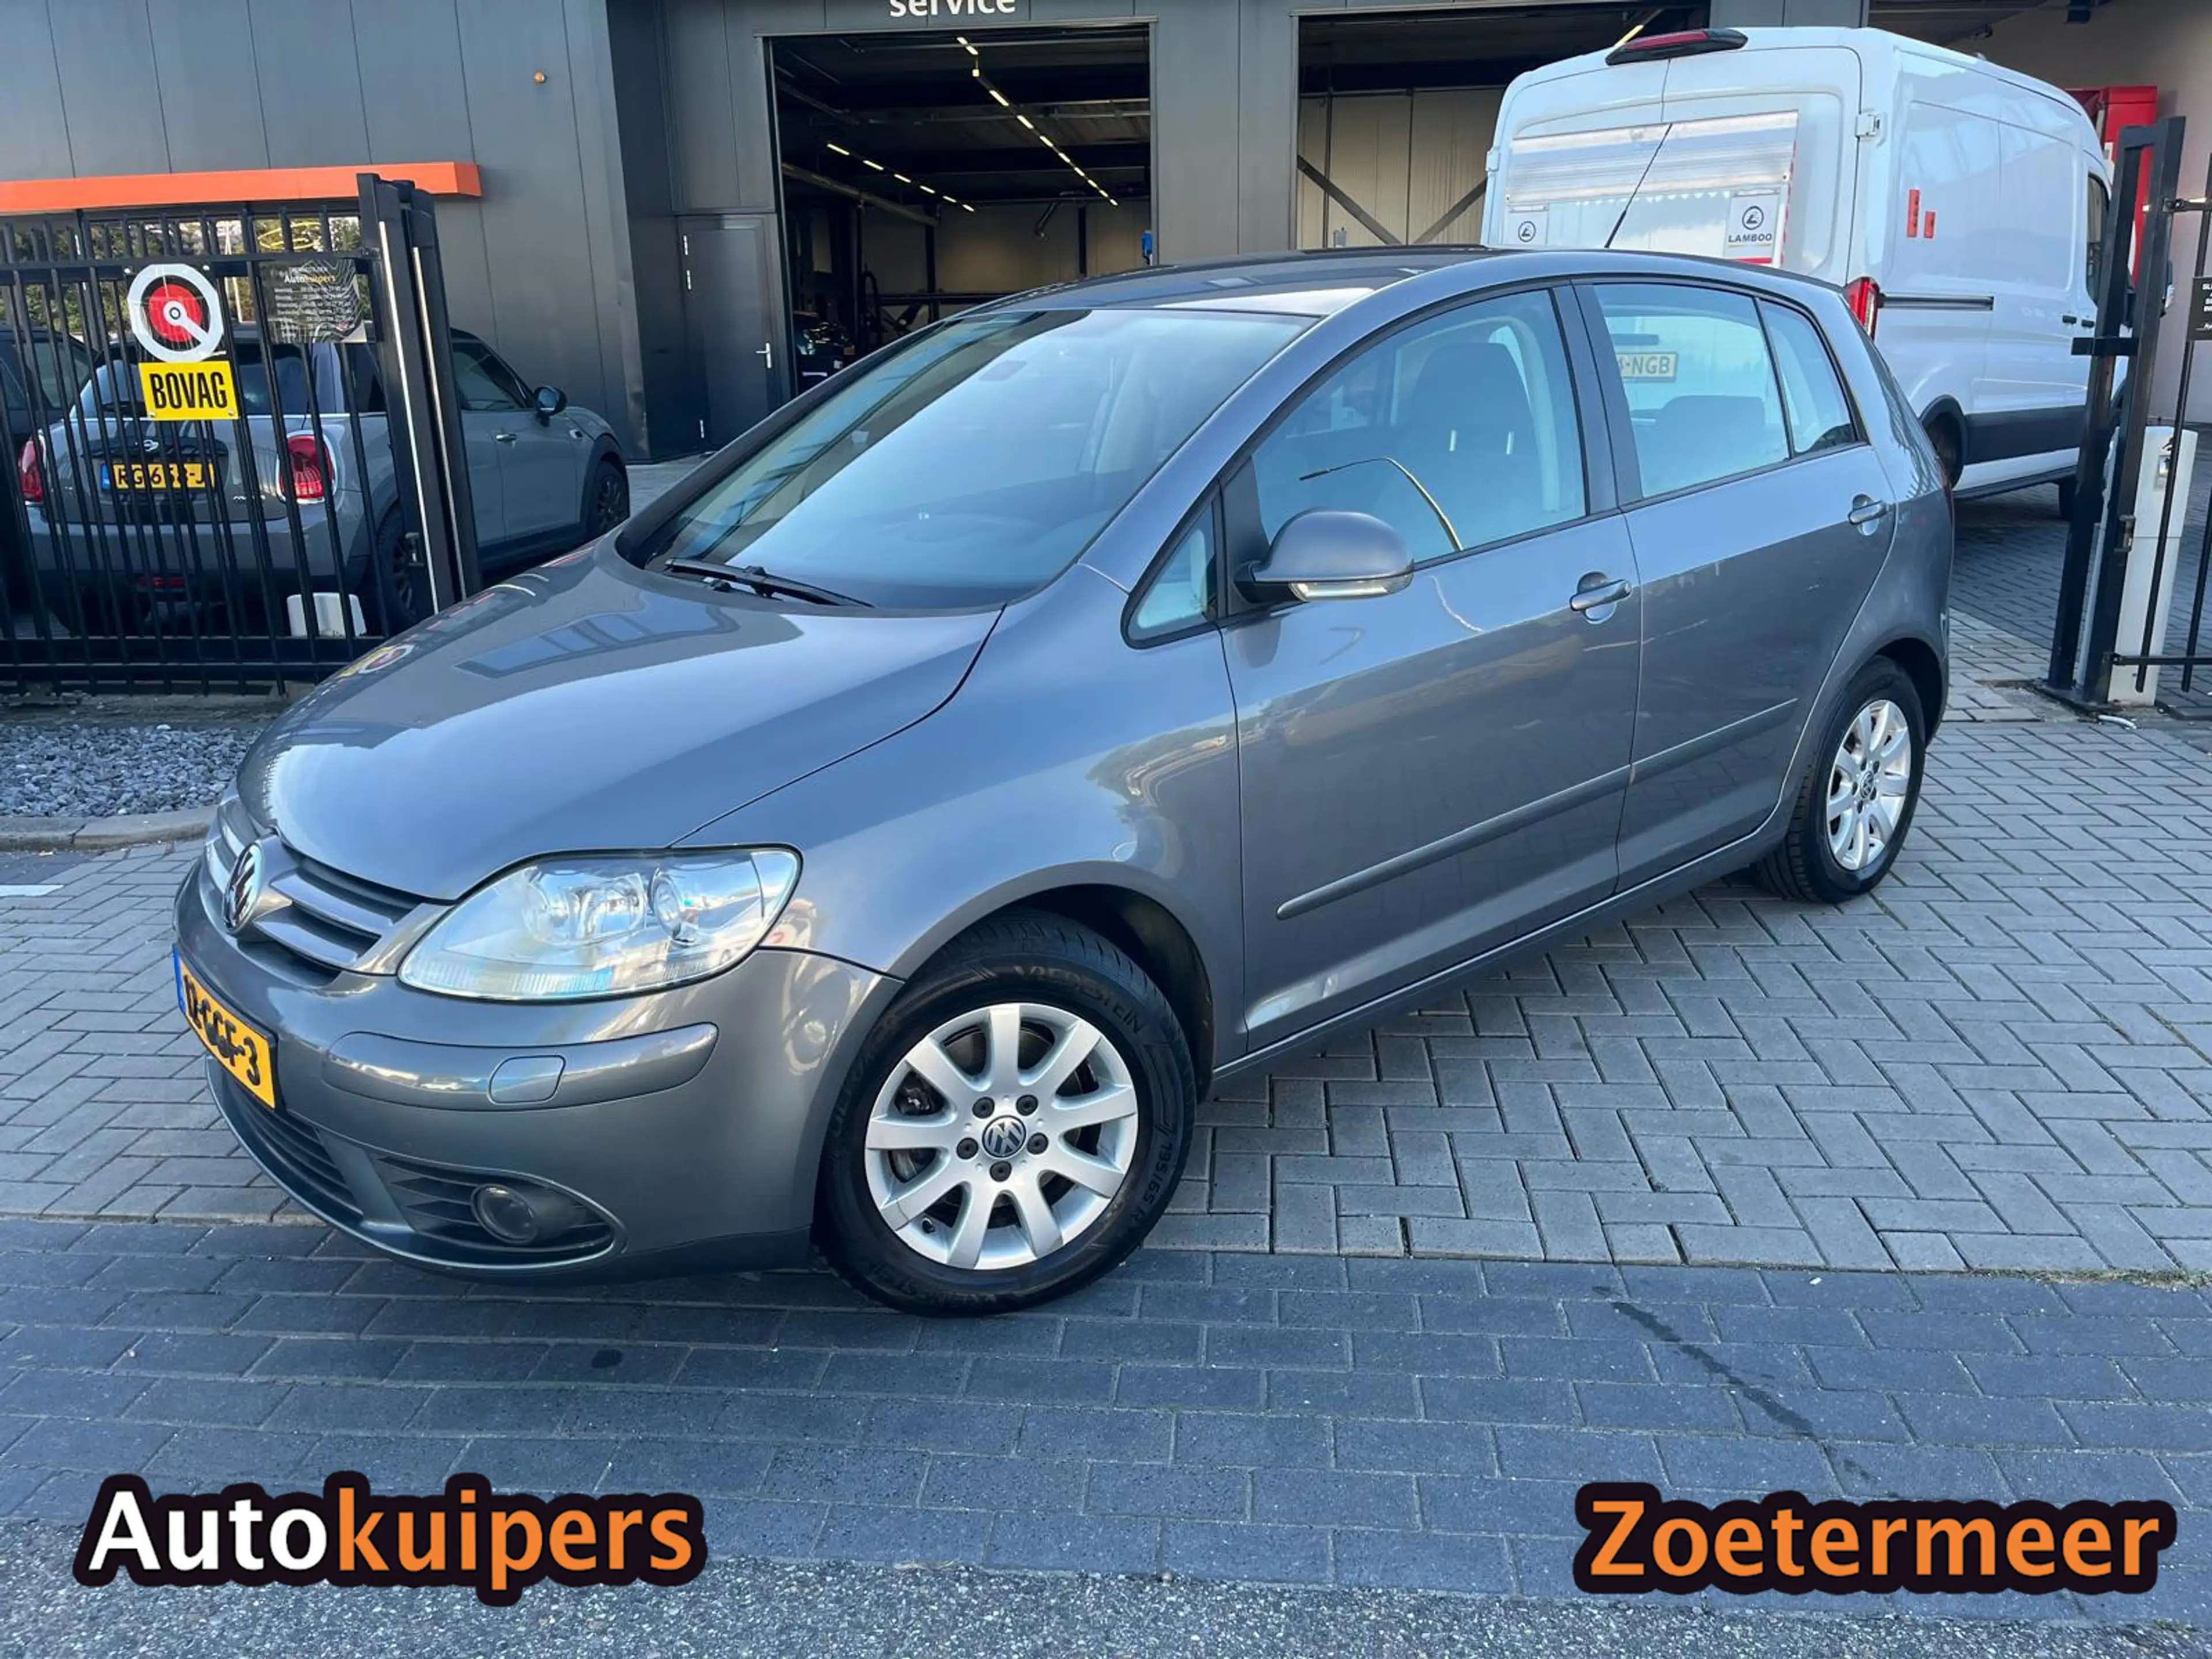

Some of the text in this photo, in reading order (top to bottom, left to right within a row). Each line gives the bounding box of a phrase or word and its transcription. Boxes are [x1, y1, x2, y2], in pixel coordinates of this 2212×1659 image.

[890, 0, 1016, 17] service
[1728, 233, 1772, 243] LAMBOO
[149, 372, 228, 409] BOVAG
